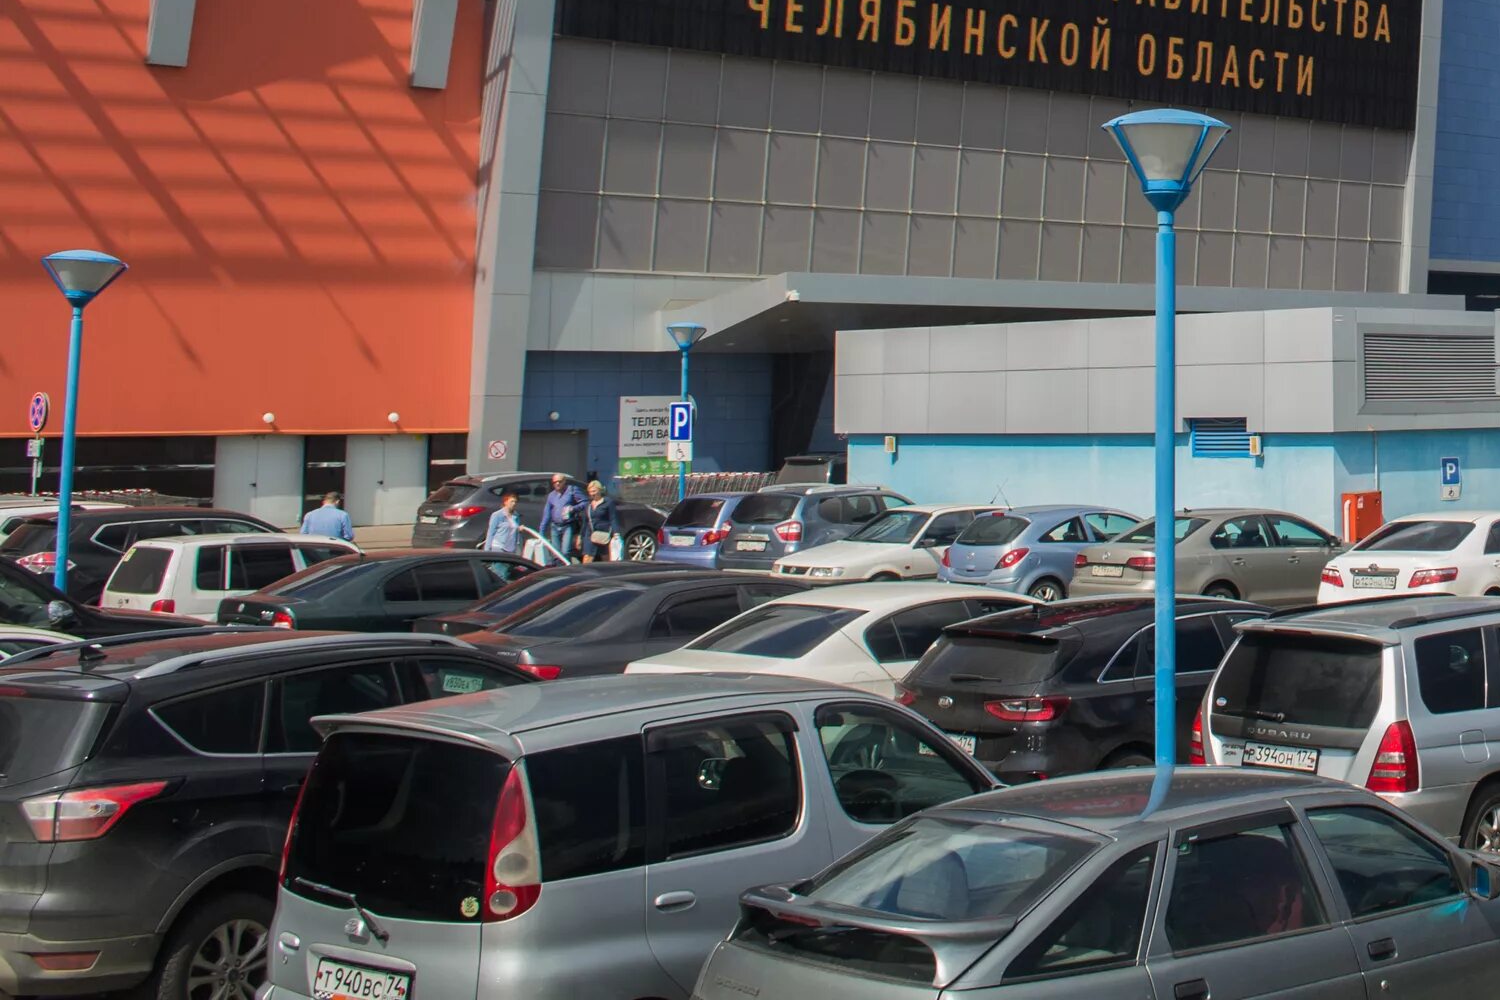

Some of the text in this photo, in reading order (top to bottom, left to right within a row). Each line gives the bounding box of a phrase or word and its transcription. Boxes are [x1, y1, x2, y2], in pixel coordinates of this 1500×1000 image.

[1137, 33, 1314, 96] ОБЛАСТИ
[632, 429, 669, 440] ДЛЯ ВА
[1248, 727, 1311, 740] SUBARU
[1247, 746, 1315, 766] Р394ОН 174
[325, 967, 405, 998] Т940ВС 74
